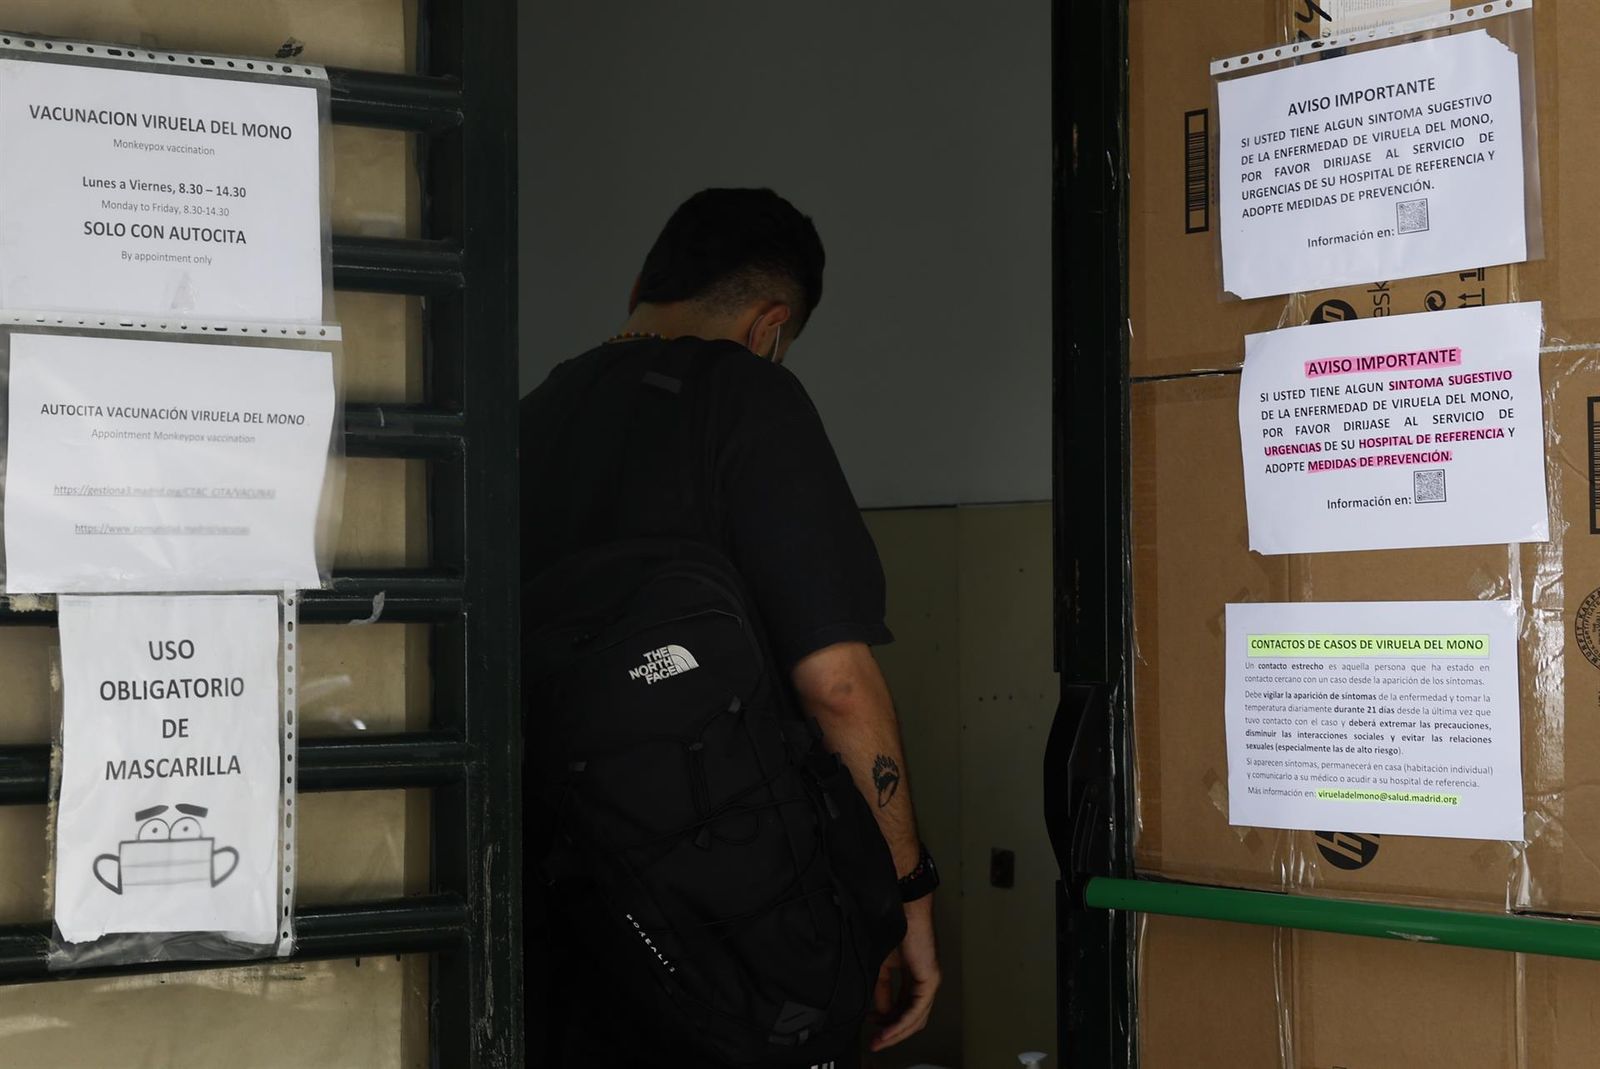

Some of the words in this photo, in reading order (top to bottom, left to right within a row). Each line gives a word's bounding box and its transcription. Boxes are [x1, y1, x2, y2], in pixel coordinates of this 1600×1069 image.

[1287, 96, 1331, 116] AVISO
[1335, 77, 1436, 106] IMPORTANTE
[29, 105, 137, 126] VACUNACION
[141, 114, 206, 132] VIRUELA
[210, 120, 238, 135] DEL
[242, 123, 292, 140] MONO
[1241, 137, 1249, 148] SI
[1253, 130, 1286, 145] USTED
[1289, 123, 1320, 138] TIENE
[1324, 116, 1363, 132] ALGUN
[1368, 107, 1423, 125] SINTOMA
[1427, 93, 1492, 114] SUGESTIVO
[113, 138, 165, 152] Monkeypox
[165, 144, 215, 155] vaccination
[1241, 154, 1254, 166] DE
[1257, 151, 1270, 162] LA
[1273, 137, 1348, 159] ENFERMEDAD
[1352, 134, 1368, 146] DE
[1371, 126, 1421, 142] VIRUELA
[1425, 121, 1446, 134] DEL
[1450, 113, 1493, 129] MONO,
[1241, 170, 1262, 183] POR
[1274, 162, 1310, 177] FAVOR
[1323, 152, 1372, 169] DIRIJASE
[1385, 148, 1400, 159] AL
[1412, 136, 1464, 154] SERVICIO
[1479, 131, 1494, 143] DE
[1241, 181, 1301, 200] URGENCIAS
[1303, 178, 1318, 190] DE
[1320, 176, 1336, 188] SU
[1339, 167, 1394, 184] HOSPITAL
[1397, 163, 1412, 176] DE
[1415, 152, 1485, 172] REFERENCIA
[1487, 150, 1495, 160] Y
[82, 176, 116, 189] Lunes
[119, 180, 126, 190] a
[129, 179, 176, 194] Viernes,
[178, 182, 203, 195] 8.30
[216, 185, 246, 198] 14.30
[101, 199, 139, 212] Monday
[140, 203, 151, 212] to
[151, 202, 182, 215] Friday,
[183, 203, 230, 216] 8.30-14.30
[1241, 202, 1284, 218] ADOPTE
[1286, 194, 1337, 211] MEDIDAS
[1340, 191, 1355, 203] DE
[1358, 179, 1434, 199] PREVENCIÓN.
[83, 221, 126, 237] SOLO
[130, 223, 164, 239] CON
[168, 226, 246, 243] AUTOCITA
[1307, 230, 1374, 247] Información
[1376, 228, 1395, 238] en:
[120, 250, 133, 262] By
[134, 252, 192, 263] appointment
[192, 254, 213, 266] only
[1308, 359, 1352, 375] AVISO
[1356, 348, 1457, 371] IMPORTANTE
[1260, 392, 1269, 403] SI
[1272, 389, 1306, 401] USTED
[1309, 385, 1340, 397] TIENE
[1344, 382, 1383, 394] ALGUN
[1388, 377, 1444, 391] SINTOMA
[1448, 370, 1512, 385] SUGESTIVO
[40, 403, 104, 416] AUTOCITA
[106, 406, 188, 420] VACUNACIÓN
[190, 410, 240, 422] VIRUELA
[242, 412, 264, 424] DEL
[266, 413, 305, 425] MONO
[1261, 409, 1274, 420] DE
[1278, 408, 1291, 419] LA
[1294, 401, 1368, 417] ENFERMEDAD
[1372, 399, 1387, 411] DE
[1391, 396, 1441, 408] VIRUELA
[1445, 393, 1466, 405] DEL
[1470, 389, 1513, 402] MONO,
[1262, 427, 1283, 438] POR
[1295, 423, 1330, 435] FAVOR
[1343, 418, 1390, 431] DIRIJASE
[1403, 416, 1418, 427] AL
[1432, 410, 1484, 424] SERVICIO
[1498, 407, 1514, 419] DE
[89, 428, 152, 440] Appointment
[152, 430, 205, 442] Monkeypox
[205, 433, 256, 443] vaccination
[1263, 442, 1322, 456] URGENCIAS
[1324, 440, 1338, 451] DE
[1340, 439, 1355, 450] SU
[1358, 435, 1413, 448] HOSPITAL
[1415, 433, 1431, 445] DE
[1434, 428, 1504, 443] REFERENCIA
[1507, 427, 1515, 437] Y
[1265, 461, 1305, 473] ADOPTE
[1307, 457, 1359, 471] MEDIDAS
[1359, 456, 1375, 467] DE
[1376, 450, 1453, 465] PREVENCIÓN.
[1327, 496, 1391, 509] Información
[1394, 495, 1412, 505] en:
[148, 639, 195, 661] USO
[643, 647, 670, 662] THE
[1251, 639, 1305, 649] CONTACTOS
[1307, 639, 1321, 649] DE
[1323, 639, 1357, 649] CASOS
[1359, 639, 1373, 649] DE
[1375, 639, 1421, 649] VIRUELA
[1423, 639, 1443, 650] DEL
[1446, 639, 1483, 650] MONO
[629, 655, 673, 681] NORTH
[645, 665, 678, 685] FACE
[99, 677, 244, 700] OBLIGATORIO
[162, 718, 189, 739] DE
[1245, 716, 1261, 724] tuvo
[1309, 718, 1318, 728] el
[1340, 720, 1346, 728] y
[1348, 718, 1377, 727] deberá
[1379, 720, 1417, 728] extremar
[1419, 719, 1431, 729] las
[1433, 721, 1492, 732] precauciones,
[1246, 729, 1277, 738] disminuir
[1282, 730, 1292, 738] las
[1298, 732, 1348, 740] interacciones
[1354, 732, 1384, 741] sociales
[1390, 734, 1396, 742] y
[1402, 734, 1425, 742] evitar
[1432, 734, 1443, 742] las
[1450, 736, 1492, 744] relaciones
[1246, 742, 1274, 751] sexuales
[1276, 744, 1331, 753] (especialmente
[1333, 745, 1344, 753] las
[1345, 746, 1355, 754] de
[1357, 746, 1373, 754] alto
[105, 756, 241, 780] MASCARILLA
[1248, 787, 1262, 795] Más
[1262, 788, 1302, 797] información
[1318, 790, 1458, 805] virueladelmono@salud.madrid.org
